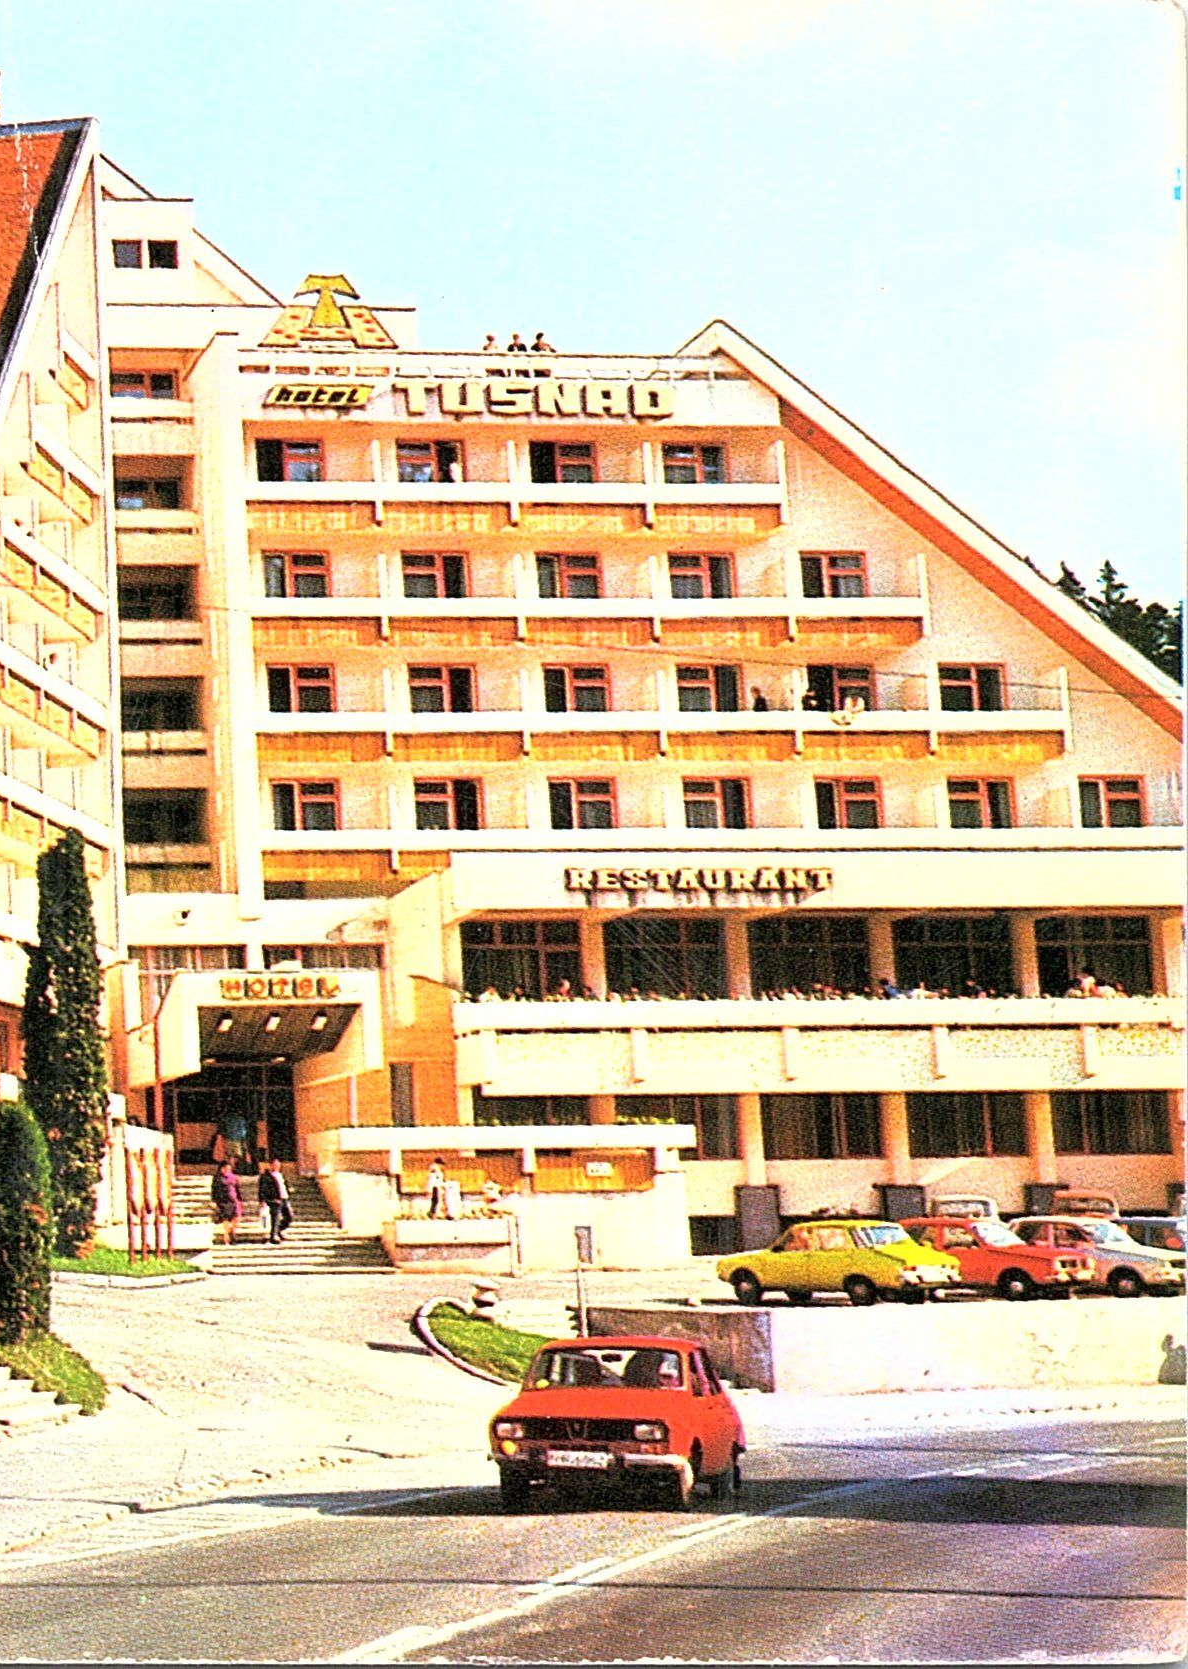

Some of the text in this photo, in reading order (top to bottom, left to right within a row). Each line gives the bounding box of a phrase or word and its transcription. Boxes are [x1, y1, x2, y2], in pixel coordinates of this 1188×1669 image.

[274, 382, 673, 418] hotel TUSNAD
[564, 867, 833, 891] RESTAURANT
[220, 977, 340, 999] HOTEL
